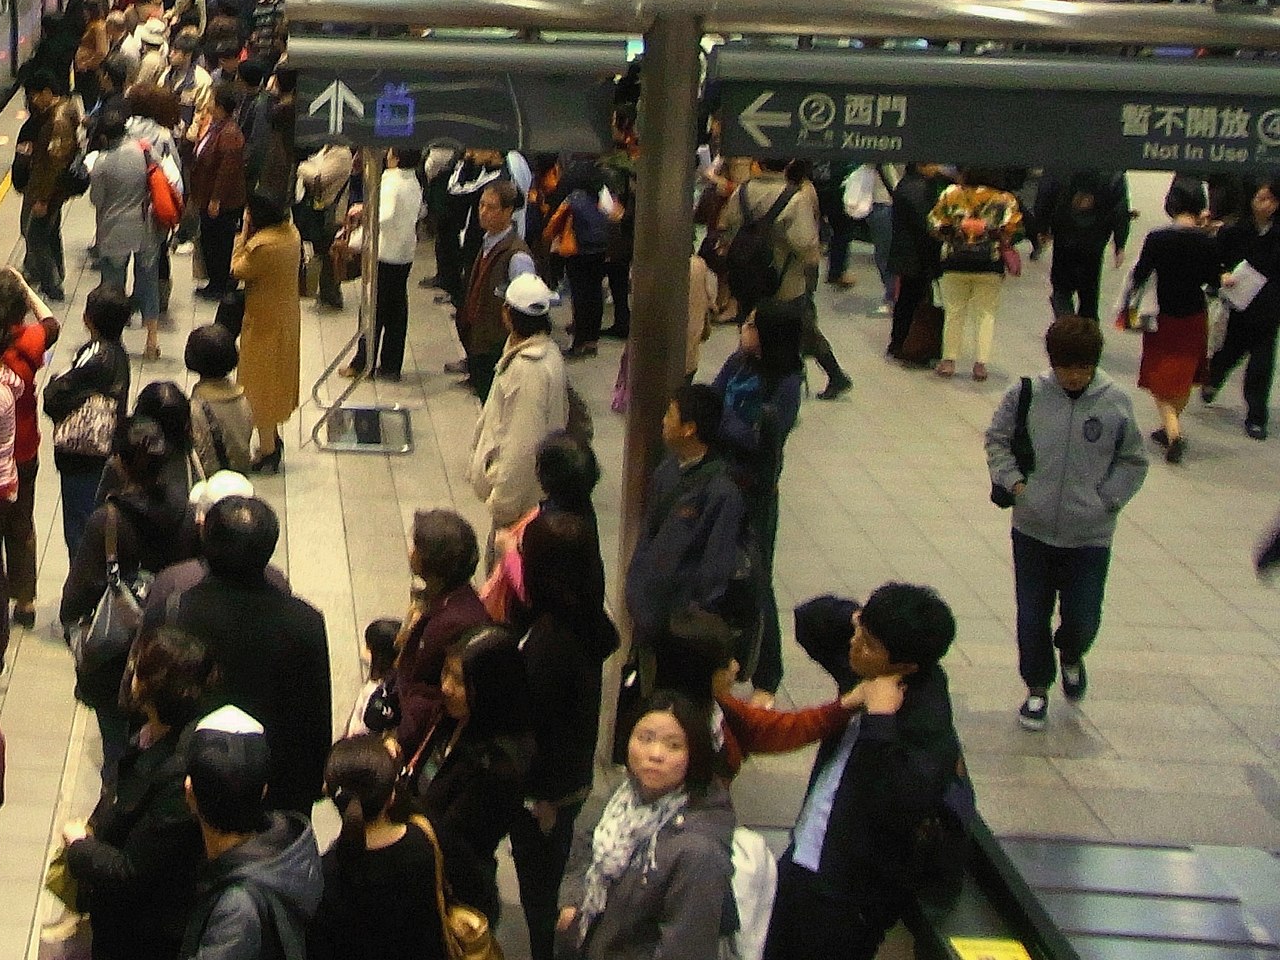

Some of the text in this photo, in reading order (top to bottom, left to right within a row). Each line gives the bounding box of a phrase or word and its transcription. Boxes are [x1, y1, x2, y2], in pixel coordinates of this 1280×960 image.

[844, 94, 907, 128] 西門
[1122, 103, 1251, 138] 暫不開放
[841, 131, 903, 150] Ximen
[1142, 141, 1180, 160] Not
[1184, 142, 1204, 160] In
[1209, 143, 1249, 162] Use
